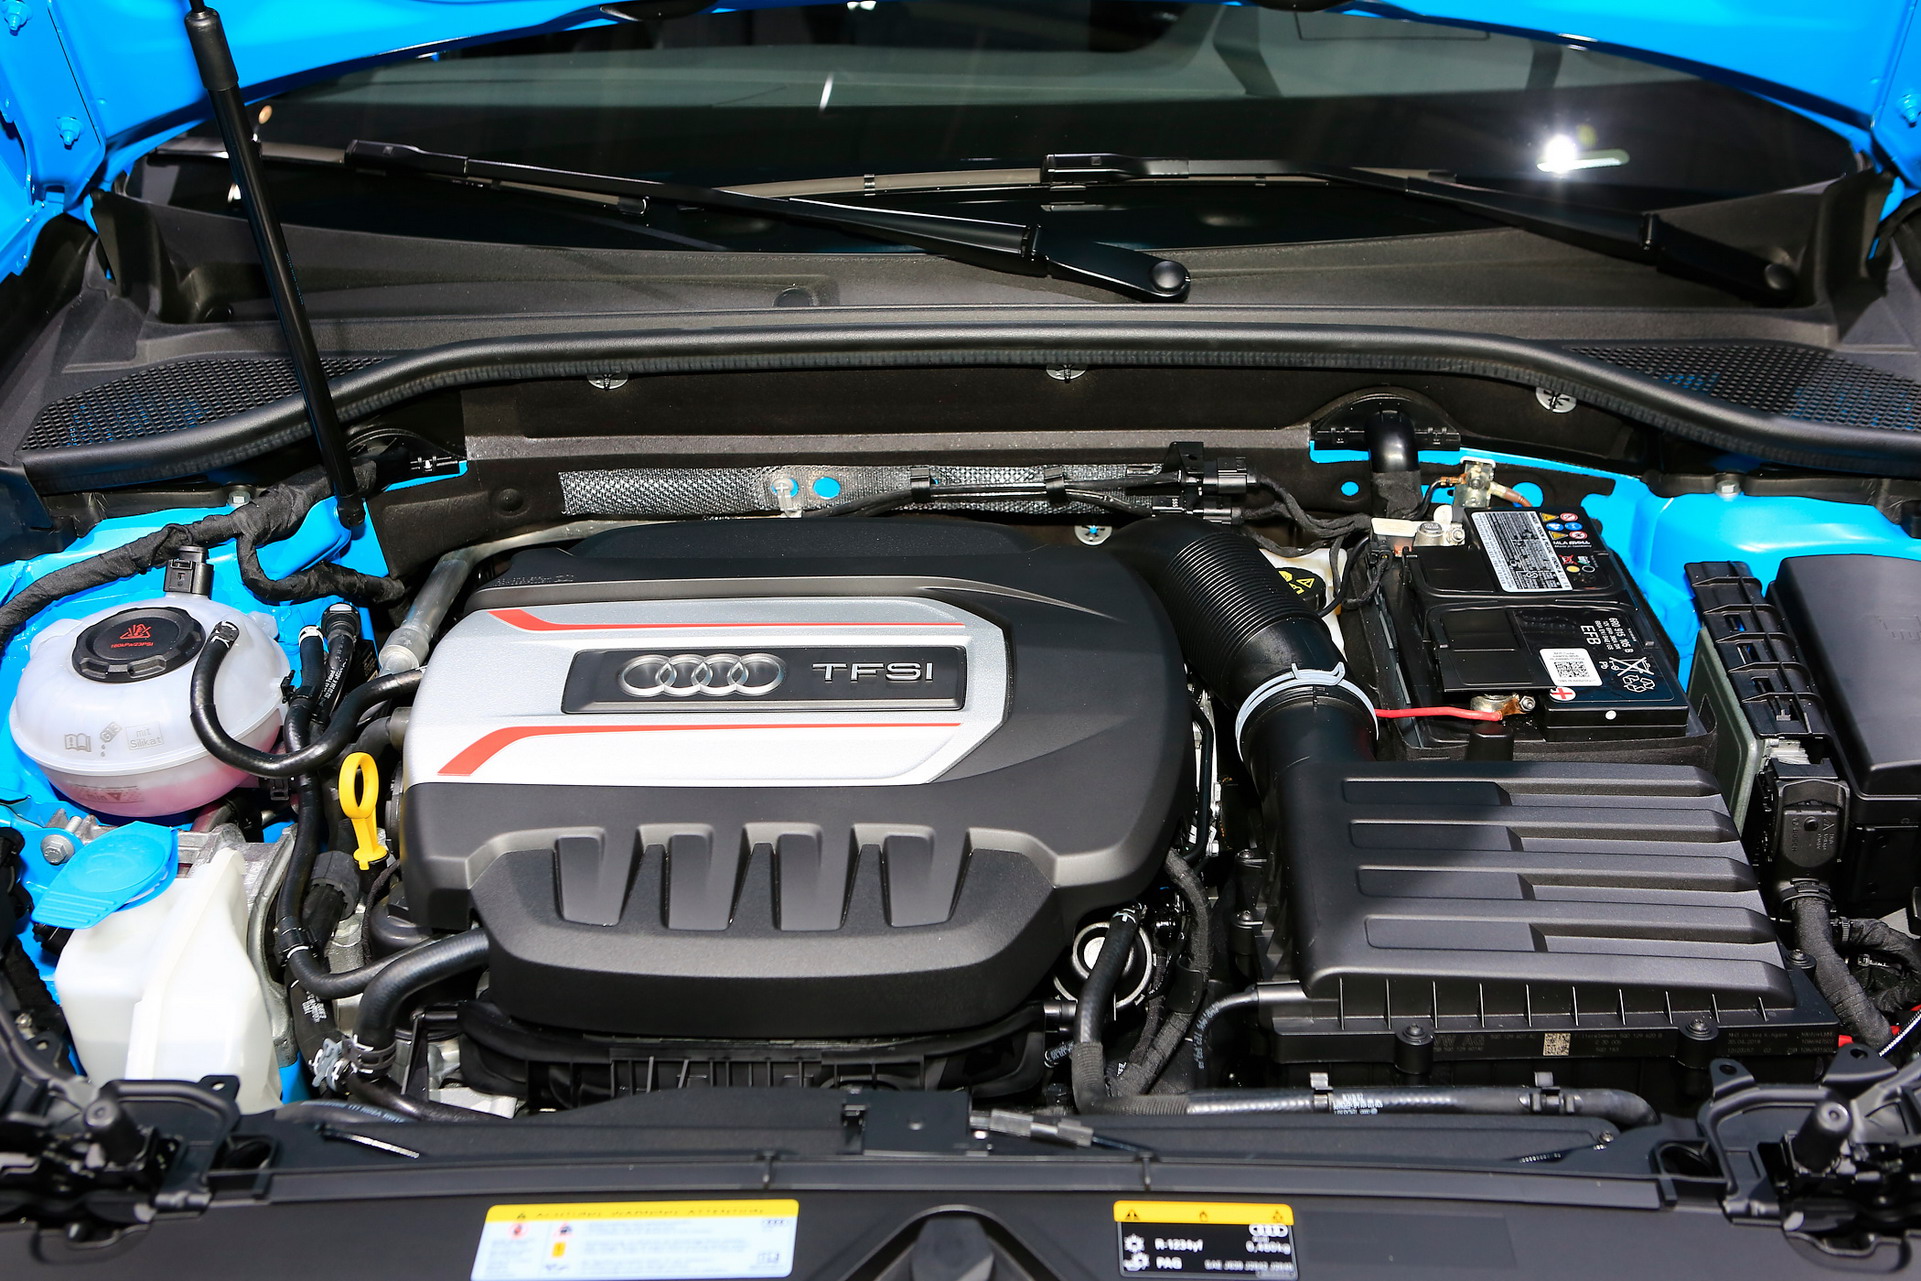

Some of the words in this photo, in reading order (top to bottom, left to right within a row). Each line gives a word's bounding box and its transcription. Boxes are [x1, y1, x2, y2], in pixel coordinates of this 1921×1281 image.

[1580, 625, 1602, 645] EFB
[1599, 661, 1609, 670] Pb
[812, 662, 934, 681] TFSI
[136, 728, 151, 738] mit
[130, 737, 162, 748] Silikat
